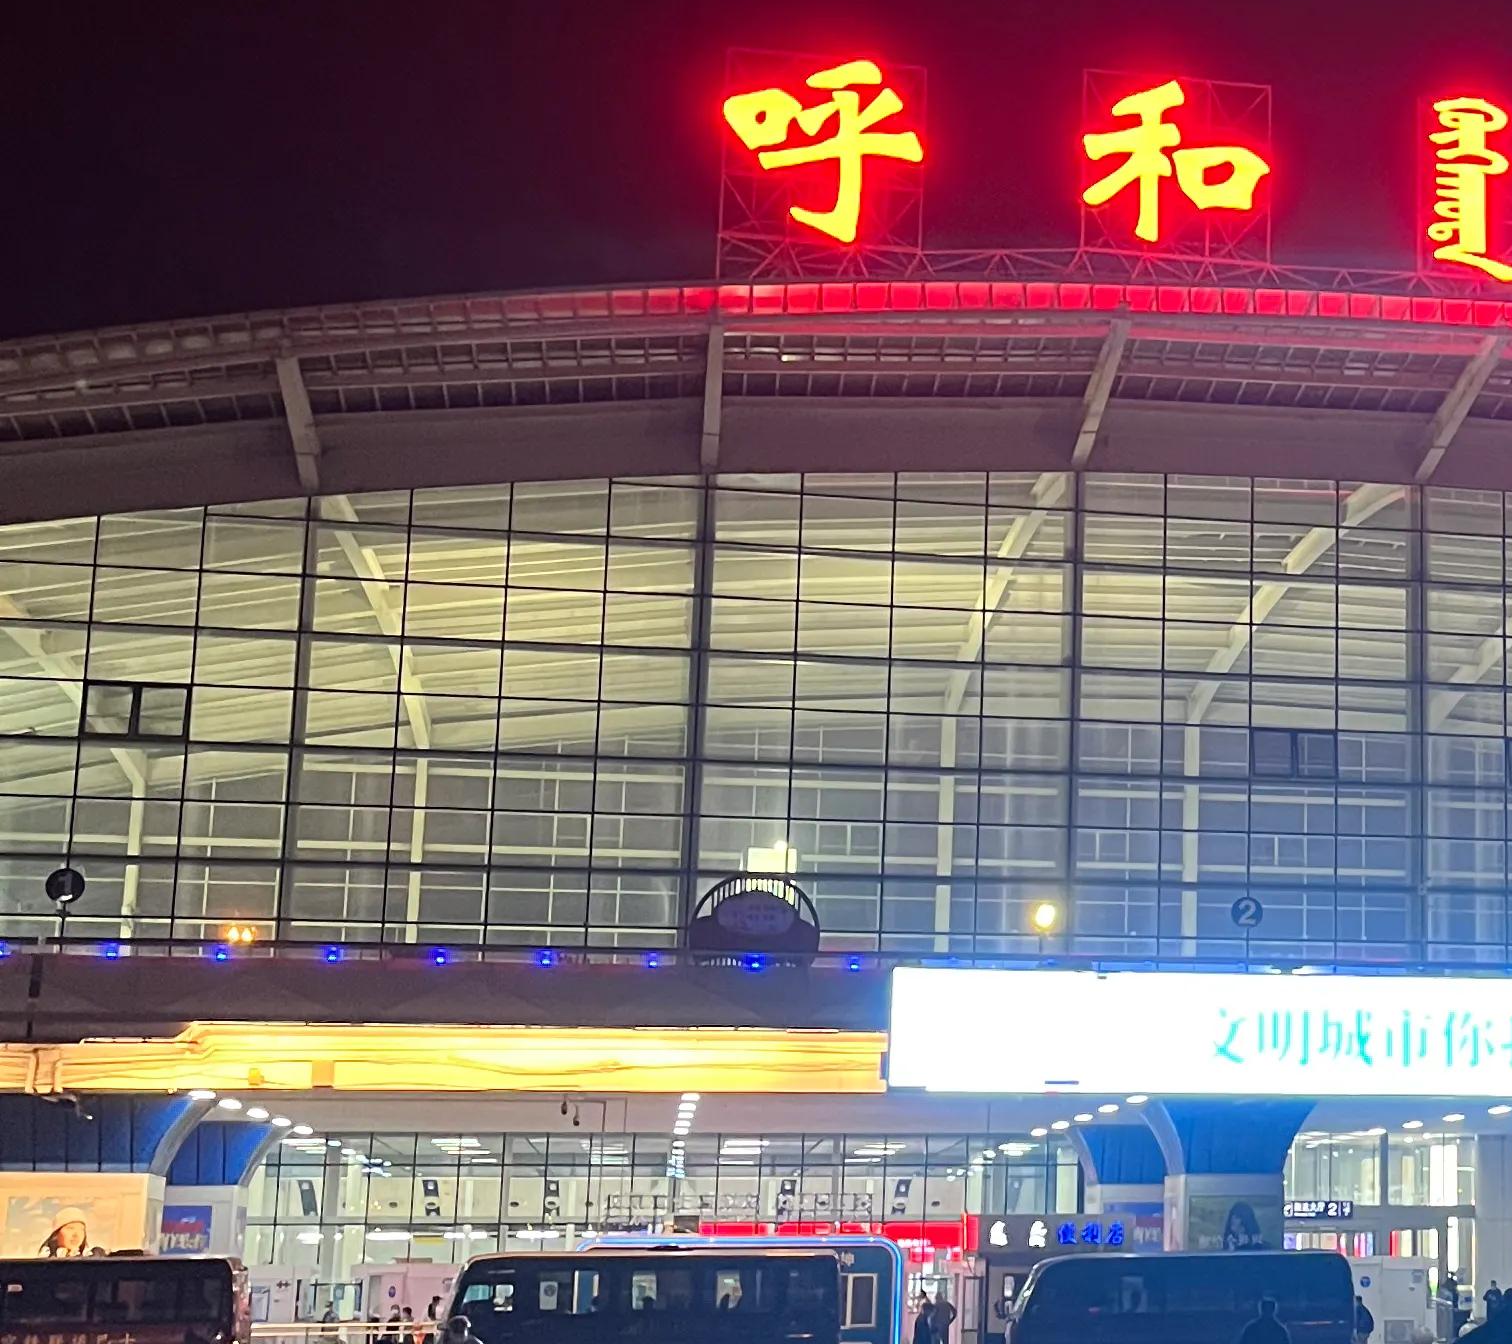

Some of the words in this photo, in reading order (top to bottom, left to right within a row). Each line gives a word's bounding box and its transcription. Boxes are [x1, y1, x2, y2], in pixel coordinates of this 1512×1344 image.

[1237, 899, 1258, 926] 2
[1057, 1221, 1125, 1245] 便利店
